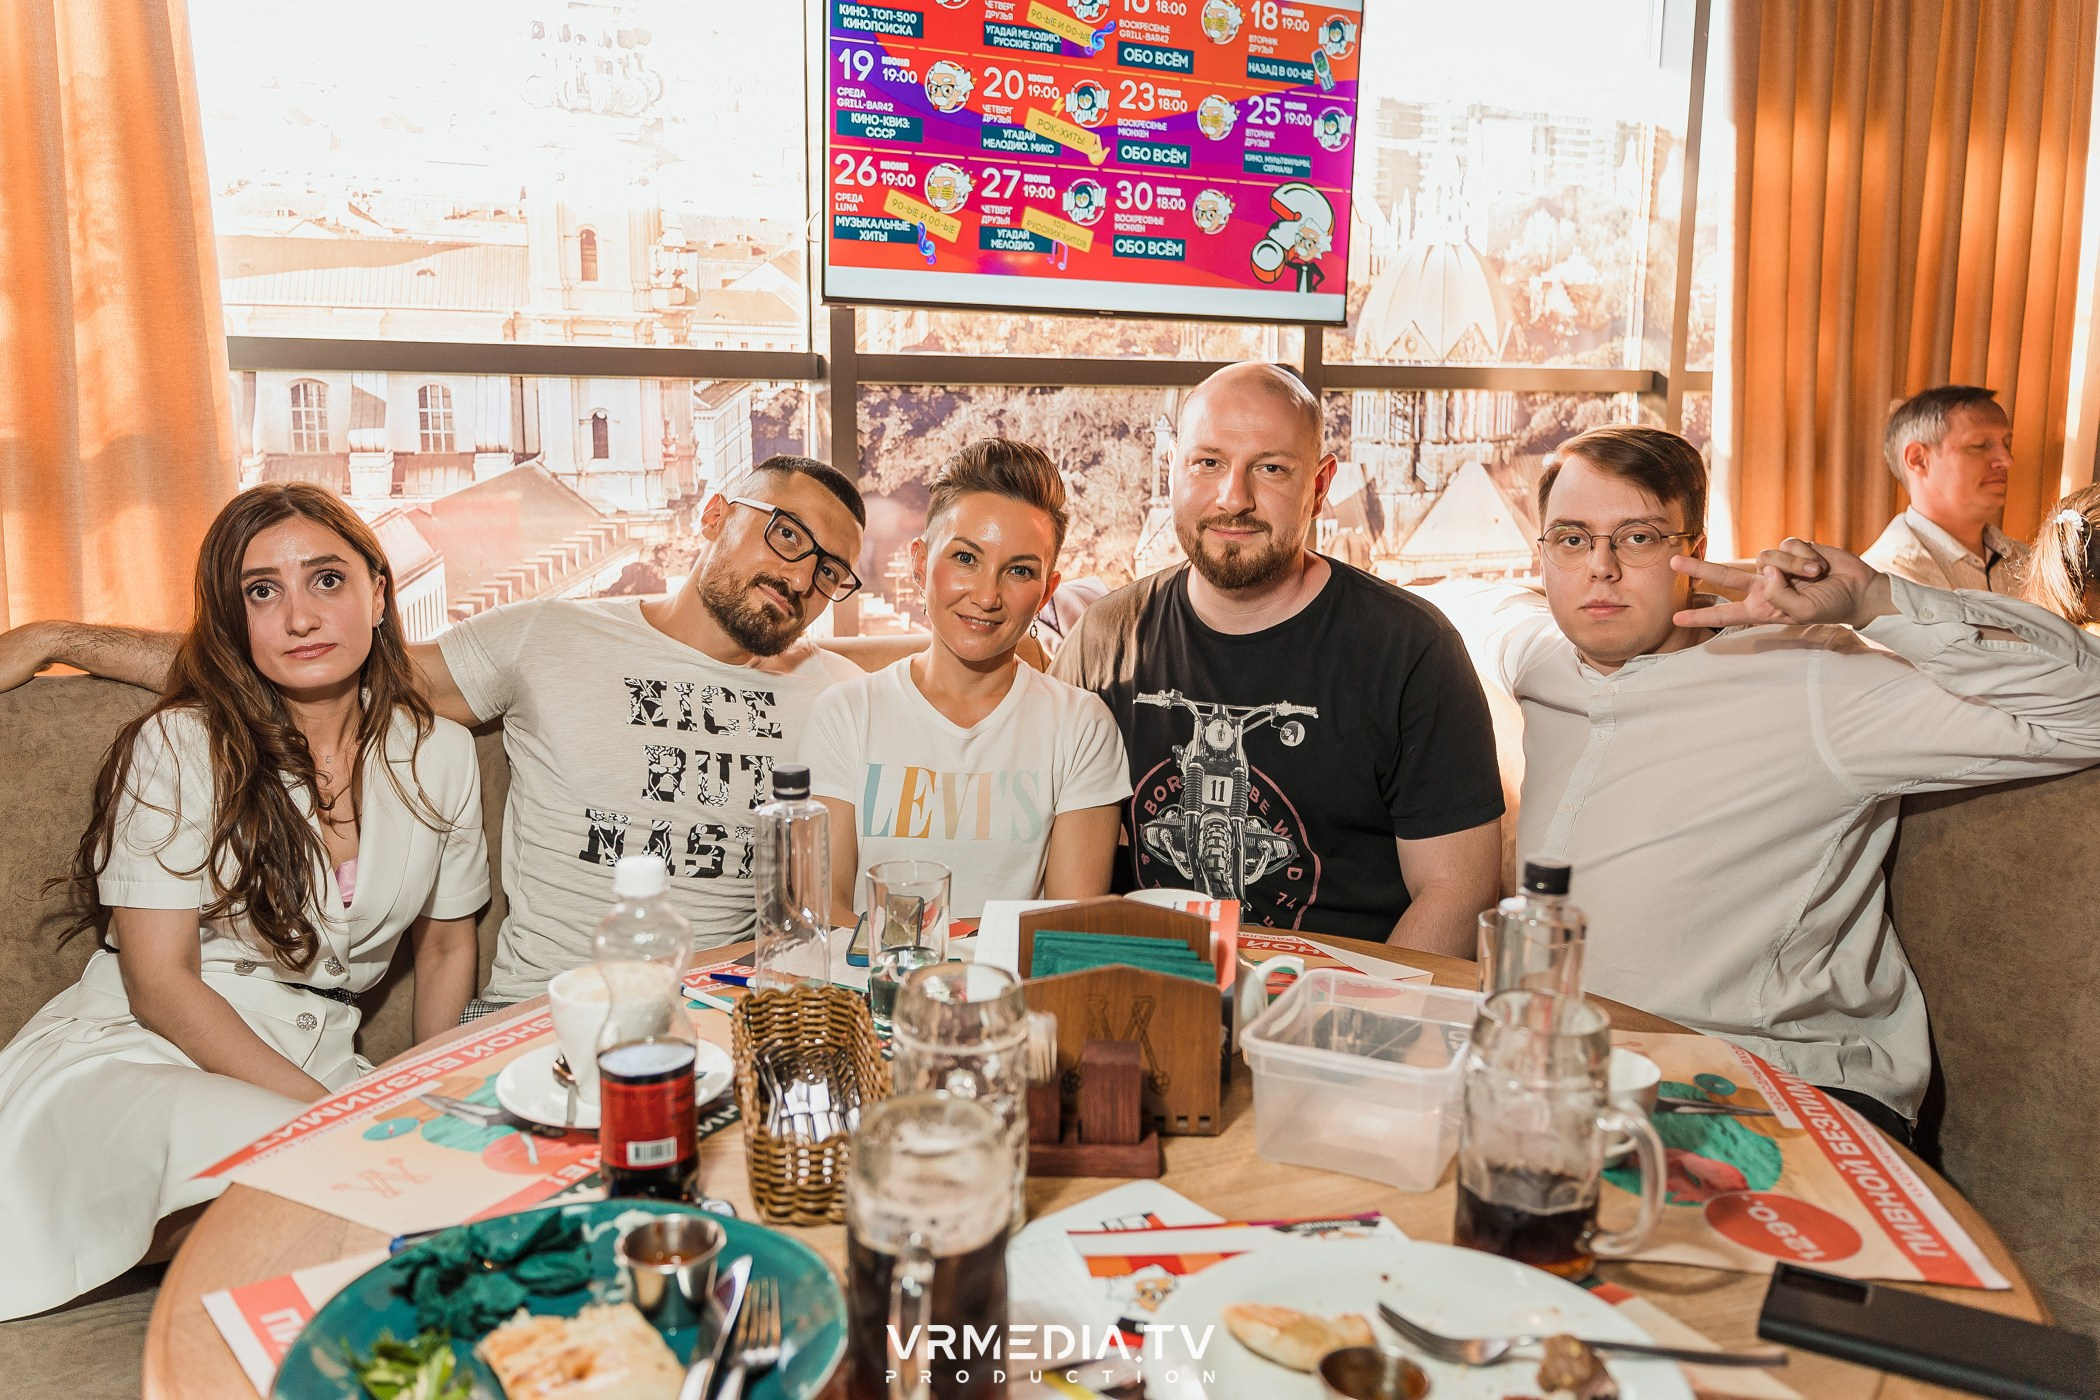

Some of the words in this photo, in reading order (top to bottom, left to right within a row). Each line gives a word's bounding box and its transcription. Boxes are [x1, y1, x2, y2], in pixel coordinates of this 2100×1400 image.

[839, 4, 870, 18] КИНО.
[872, 8, 917, 25] ТОП-500
[1156, 0, 1187, 16] 18:00
[1251, 1, 1278, 31] 18
[1031, 9, 1057, 26] 90-ЫЕ
[1281, 17, 1310, 33] 19:00
[843, 17, 913, 36] КИНОПОИСКА
[986, 25, 1018, 38] УГАДАЙ
[1018, 29, 1062, 44] МЕЛОДИЮ.
[993, 36, 1031, 50] РУССКИЕ
[1031, 41, 1054, 53] ХИТЫ
[1119, 29, 1170, 43] GRILL-BAR42
[837, 48, 874, 82] 19
[1124, 48, 1153, 65] ОБО
[1155, 51, 1189, 69] ВСЁМ
[882, 67, 918, 85] 19:00
[1248, 62, 1278, 76] НАЗАД
[1279, 65, 1286, 76] В
[982, 66, 1024, 100] 20
[837, 87, 867, 99] СРЕДА
[1027, 84, 1060, 100] 19:00
[1119, 79, 1155, 112] 23
[837, 98, 894, 112] GRILL-BAR42
[982, 104, 1013, 115] ЧЕТВЕРГ
[1157, 97, 1188, 113] 18:00
[1246, 95, 1282, 126] 25
[851, 112, 911, 129] КИНО-КВИЗ:
[982, 114, 1012, 125] ДРУЗЬЯ
[1284, 112, 1313, 127] 19:00
[865, 127, 896, 140] СССР
[1037, 119, 1086, 145] РОК-ХИТЫ
[983, 138, 1030, 152] МЕЛОДИЮ.
[1031, 142, 1055, 154] МИКС
[1121, 145, 1151, 161] ОБО
[1152, 147, 1187, 165] ВСЁМ
[834, 153, 878, 187] 26
[881, 172, 916, 188] 19:00
[981, 167, 1021, 200] 27
[835, 192, 864, 204] СРЕДА
[1023, 184, 1056, 200] 19:00
[1115, 180, 1153, 211] 30
[835, 202, 859, 213] LUNA
[891, 199, 921, 220] 90-ЫЕ
[981, 204, 1013, 215] ЧЕТВЕРГ
[1156, 197, 1187, 211] 18:00
[836, 216, 911, 232] МУЗЫКАЛЬНЫЕ
[981, 215, 1011, 226] ДРУЗЬЯ
[859, 230, 888, 242] ХИТЫ
[997, 228, 1030, 240] УГАДАЙ
[990, 239, 1035, 251] МЕЛОДИЮ
[1115, 239, 1148, 255] ОБО
[1149, 240, 1183, 257] ВСЁМ
[624, 677, 783, 739] NICE
[641, 744, 776, 810] BUT
[1210, 779, 1226, 803] 11
[1249, 785, 1271, 816] BE
[579, 808, 756, 879] NAST
[1246, 940, 1321, 955] НОЙ
[461, 1016, 553, 1062] ВНОЙ
[1768, 1066, 1864, 1158] БЕЗЛИМИ
[1839, 1156, 1949, 1258] ПИВНОЙ
